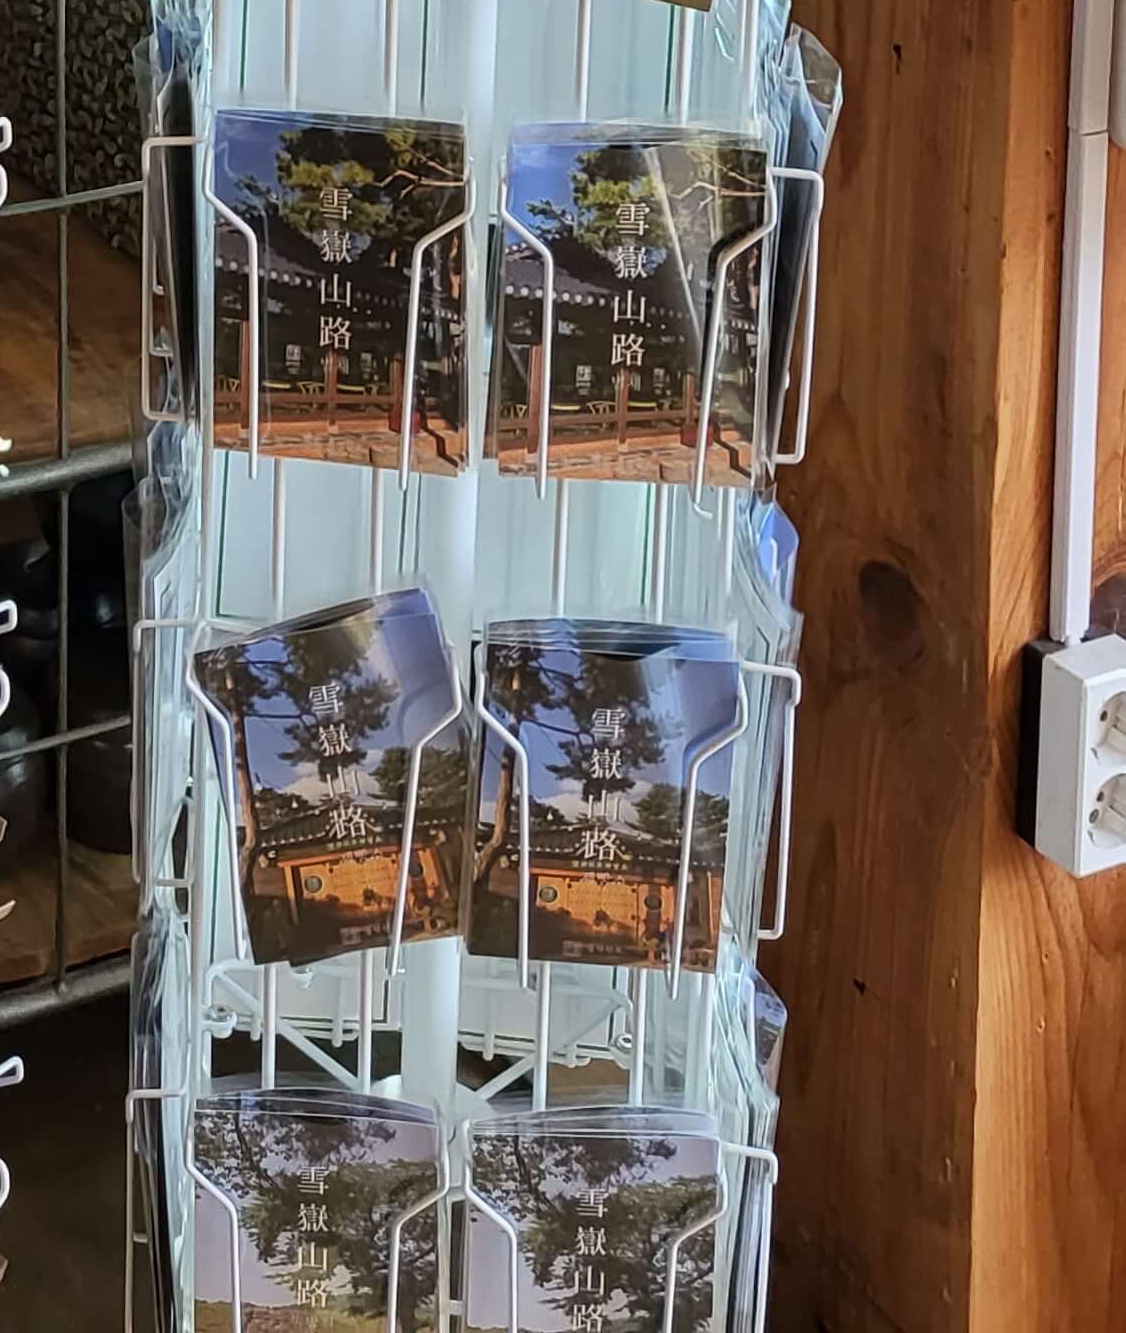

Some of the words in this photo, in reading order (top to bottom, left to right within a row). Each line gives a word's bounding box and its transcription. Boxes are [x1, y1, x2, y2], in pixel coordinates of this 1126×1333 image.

[318, 187, 353, 350] 雪嶽山路
[611, 202, 651, 367] 雪嶽山路
[308, 683, 367, 838] 雪嶽山路
[582, 708, 626, 861] 雪嶽山路
[297, 1166, 329, 1309] 雪嶽山路
[571, 1188, 609, 1332] 雪嶽山路
